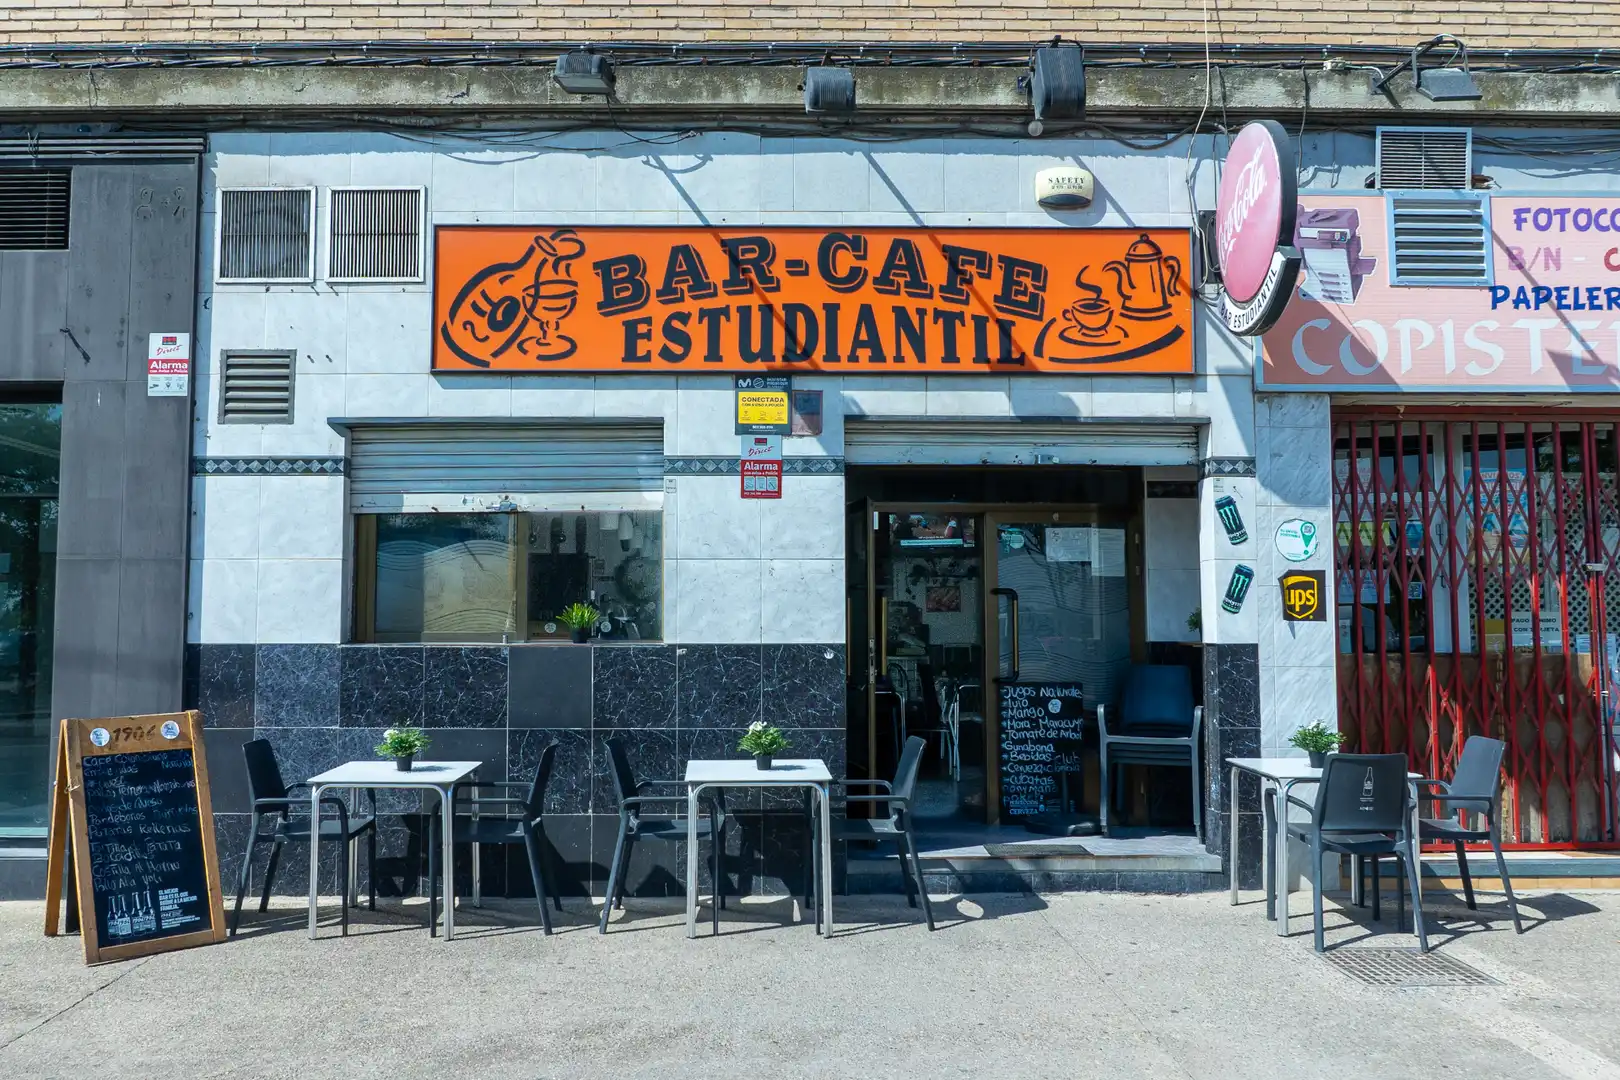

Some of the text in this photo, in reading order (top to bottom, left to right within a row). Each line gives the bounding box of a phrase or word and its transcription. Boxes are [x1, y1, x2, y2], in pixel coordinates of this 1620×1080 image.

[1508, 246, 1561, 271] B/N
[593, 232, 1048, 321] BAR-CAFE
[1234, 269, 1277, 328] ESTUDIANTIL
[622, 303, 1025, 365] ESTUDIANTIL
[150, 360, 188, 369] Alarma
[744, 461, 778, 471] Alarma
[1286, 589, 1315, 612] ups
[1004, 686, 1036, 699] Jugos
[1008, 706, 1045, 719] Mango
[1007, 719, 1030, 729] Mora
[112, 725, 156, 742] 1906
[1005, 729, 1046, 740] Tomate
[1046, 728, 1058, 738] de
[1010, 751, 1052, 761] Bebidas
